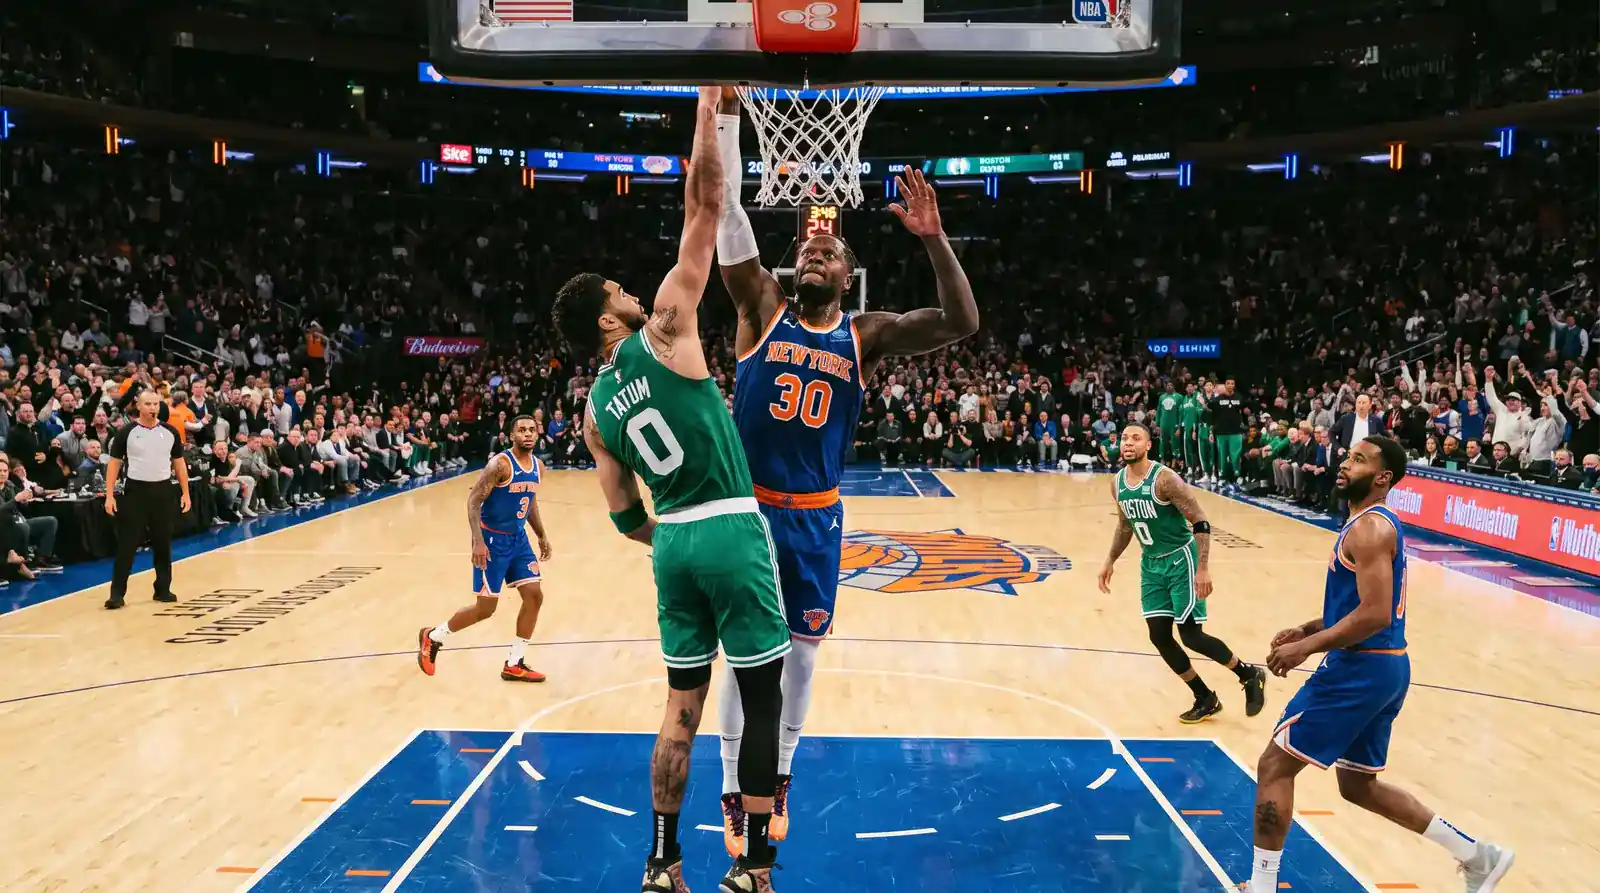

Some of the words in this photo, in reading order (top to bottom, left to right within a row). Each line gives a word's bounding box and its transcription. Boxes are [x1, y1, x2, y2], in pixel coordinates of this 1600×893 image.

[1080, 2, 1101, 17] NBA
[406, 338, 479, 354] Budweiser
[605, 376, 651, 420] TATUM
[769, 372, 833, 428] 30
[626, 407, 684, 476] 0
[516, 496, 529, 519] 3
[1134, 521, 1154, 546] 0
